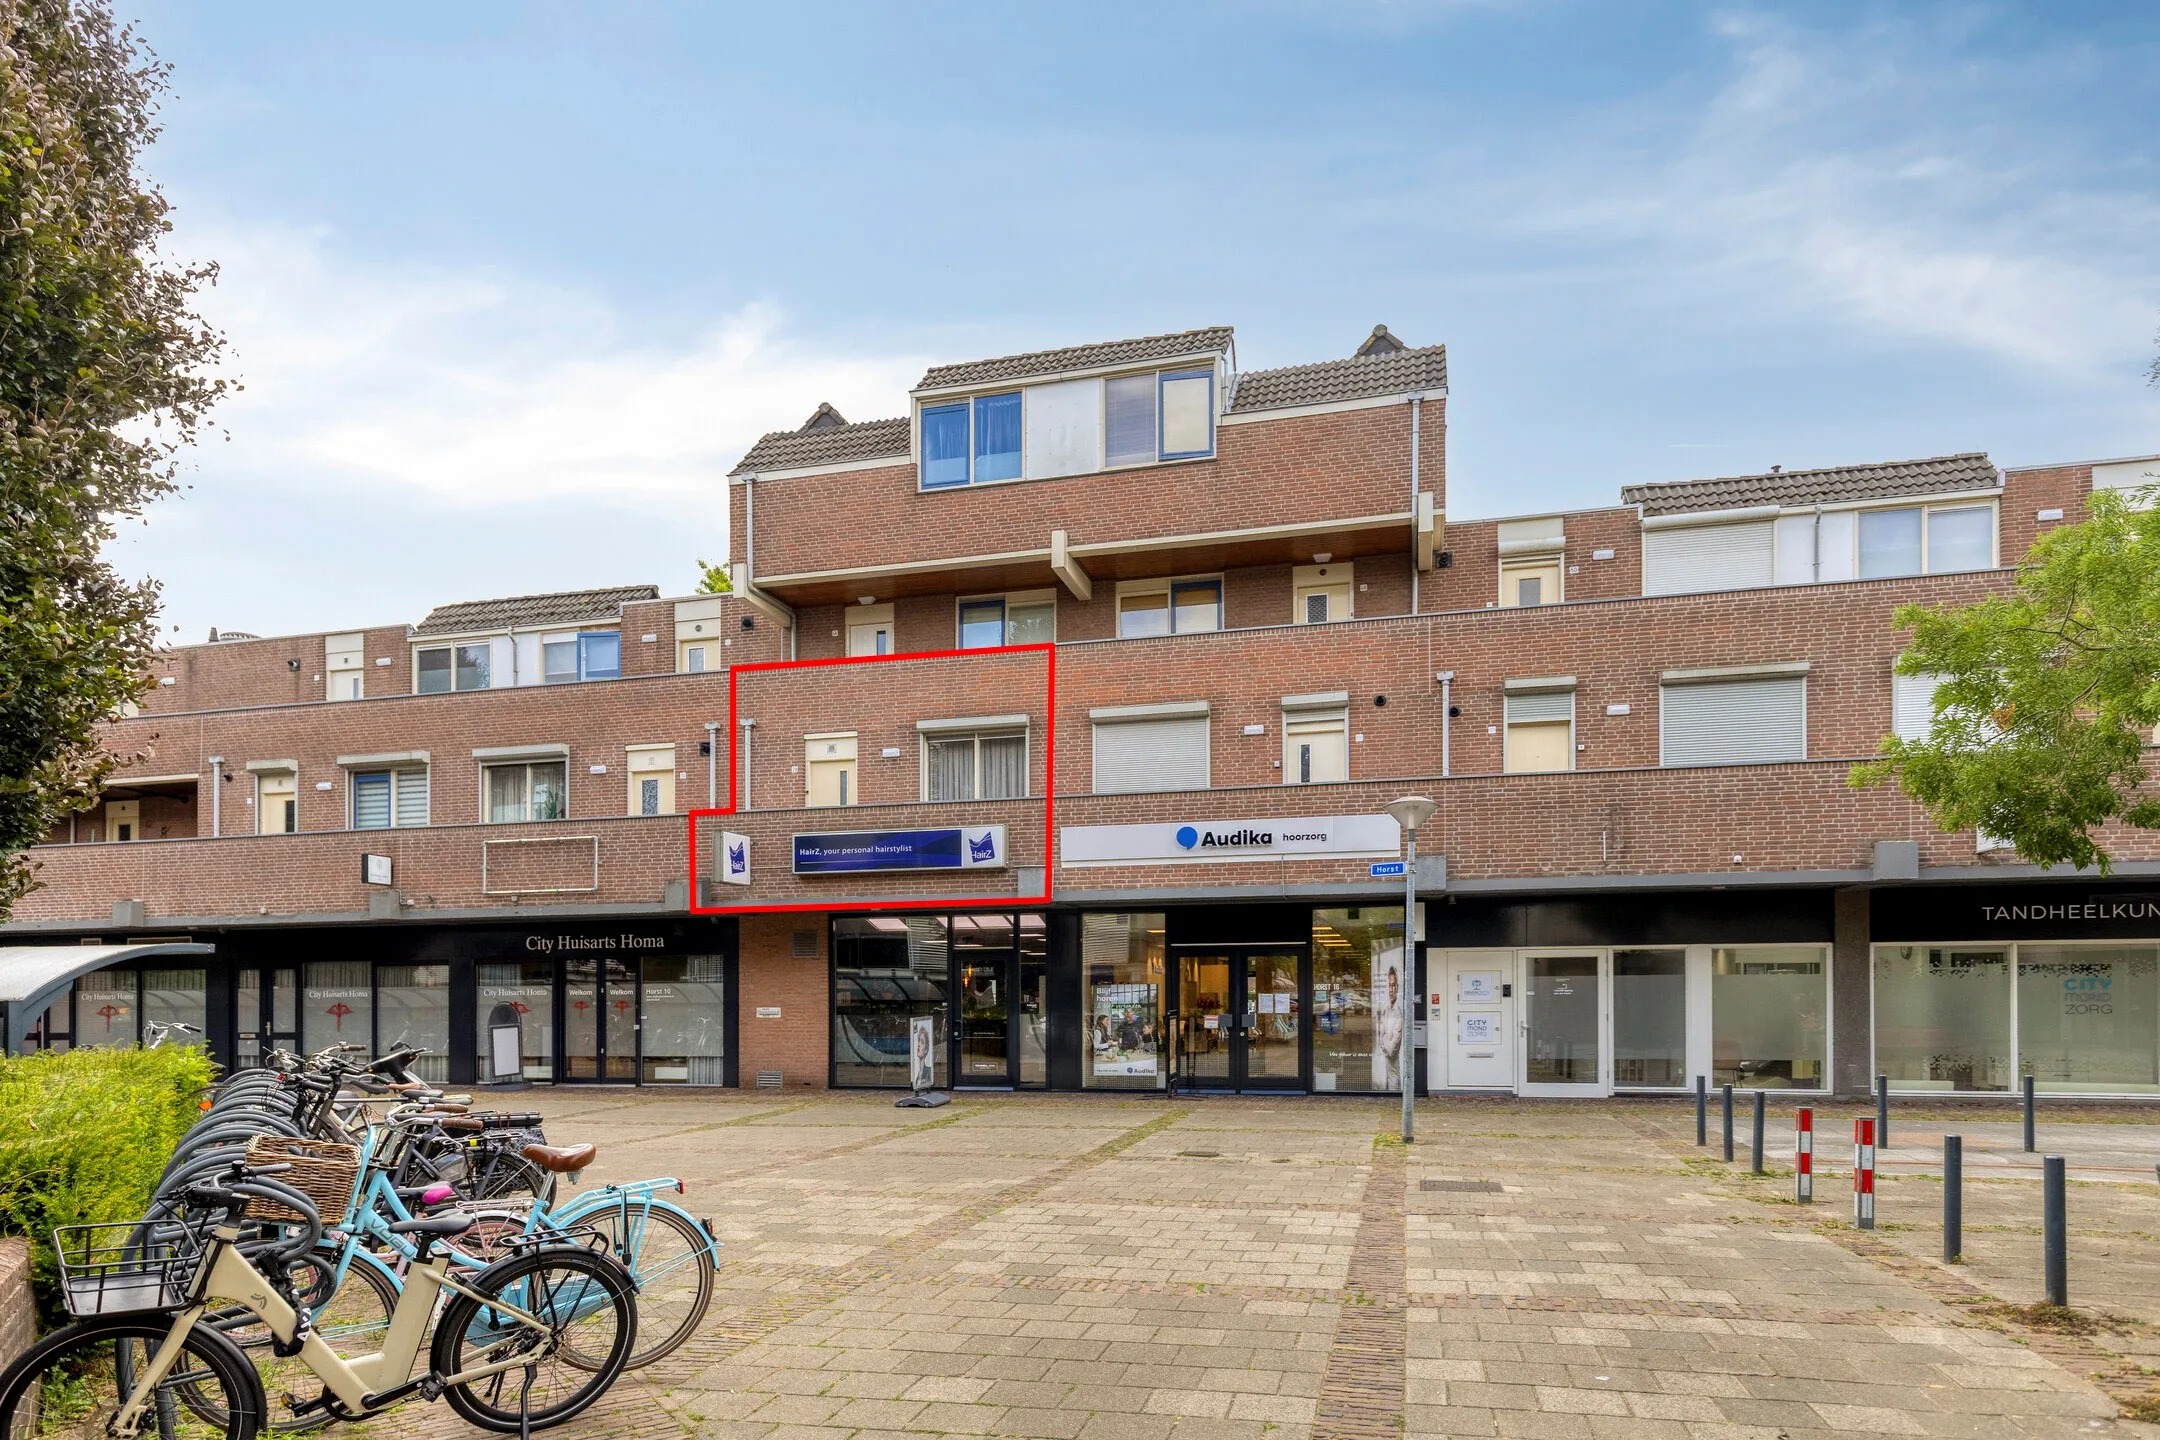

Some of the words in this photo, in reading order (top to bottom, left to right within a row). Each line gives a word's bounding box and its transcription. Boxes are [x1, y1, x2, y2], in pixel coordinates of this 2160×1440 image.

[1201, 829, 1273, 847] Audika
[1282, 832, 1327, 841] hoorzorg
[800, 848, 822, 857] HairZ,
[823, 848, 840, 856] your
[841, 846, 874, 856] personal
[875, 845, 912, 854] hairstylist
[971, 849, 992, 860] HairZ
[730, 859, 744, 872] HairZ
[1376, 865, 1399, 874] Horst
[1981, 903, 2160, 921] TANDHEELKUN
[525, 936, 554, 954] City
[557, 935, 616, 950] Huisarts
[620, 934, 665, 949] Homa
[1313, 983, 1331, 991] HORST
[1333, 983, 1340, 991] 16
[2064, 977, 2112, 991] CITY
[81, 993, 93, 1002] City
[309, 991, 322, 999] City
[349, 990, 368, 998] Homa
[483, 988, 497, 998] City
[2064, 1004, 2113, 1015] ZORG
[371, 1218, 416, 1258] VOGU
